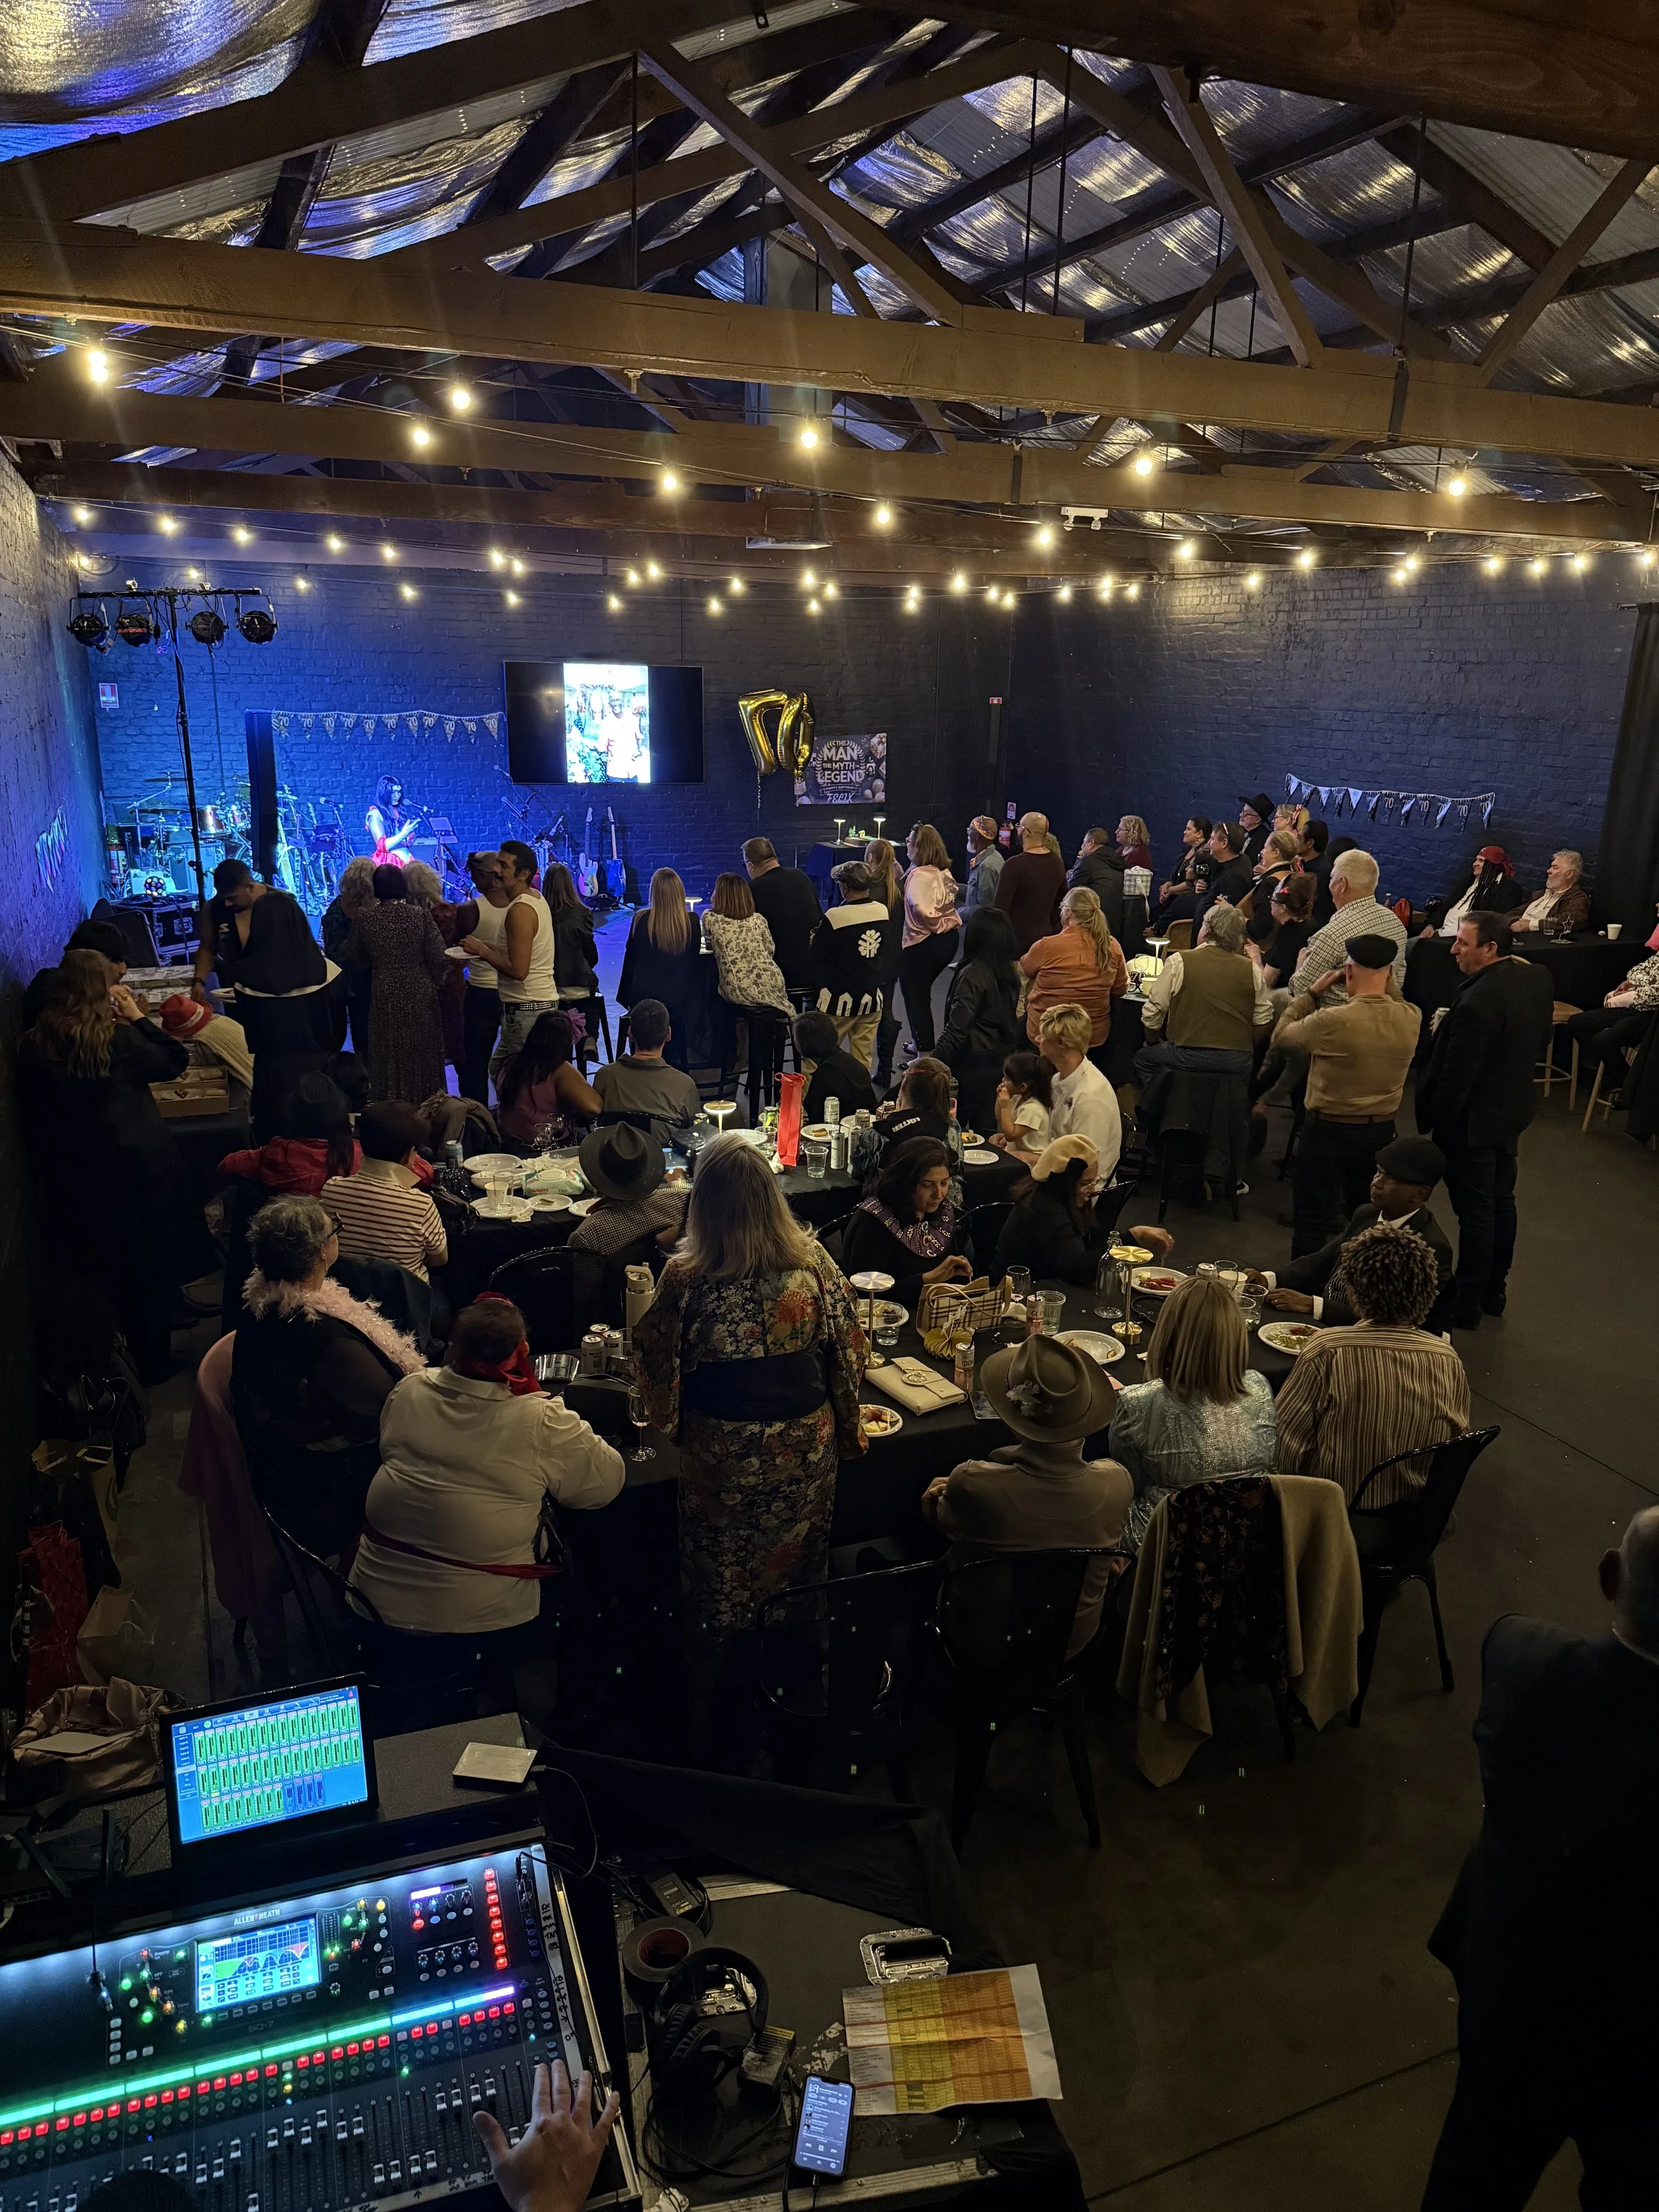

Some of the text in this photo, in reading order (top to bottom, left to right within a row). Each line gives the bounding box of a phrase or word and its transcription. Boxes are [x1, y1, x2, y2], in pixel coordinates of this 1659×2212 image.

[280, 715, 498, 731] 70 70 70 70 70 70 70 70 70 70 70
[739, 689, 815, 775] 70
[823, 747, 859, 761] MAN
[832, 761, 855, 770] MYTH
[817, 770, 865, 782] LEGEND
[827, 792, 855, 804] FELIX
[1385, 797, 1394, 808] 70
[1419, 800, 1429, 812] 70
[1460, 804, 1468, 816] 70
